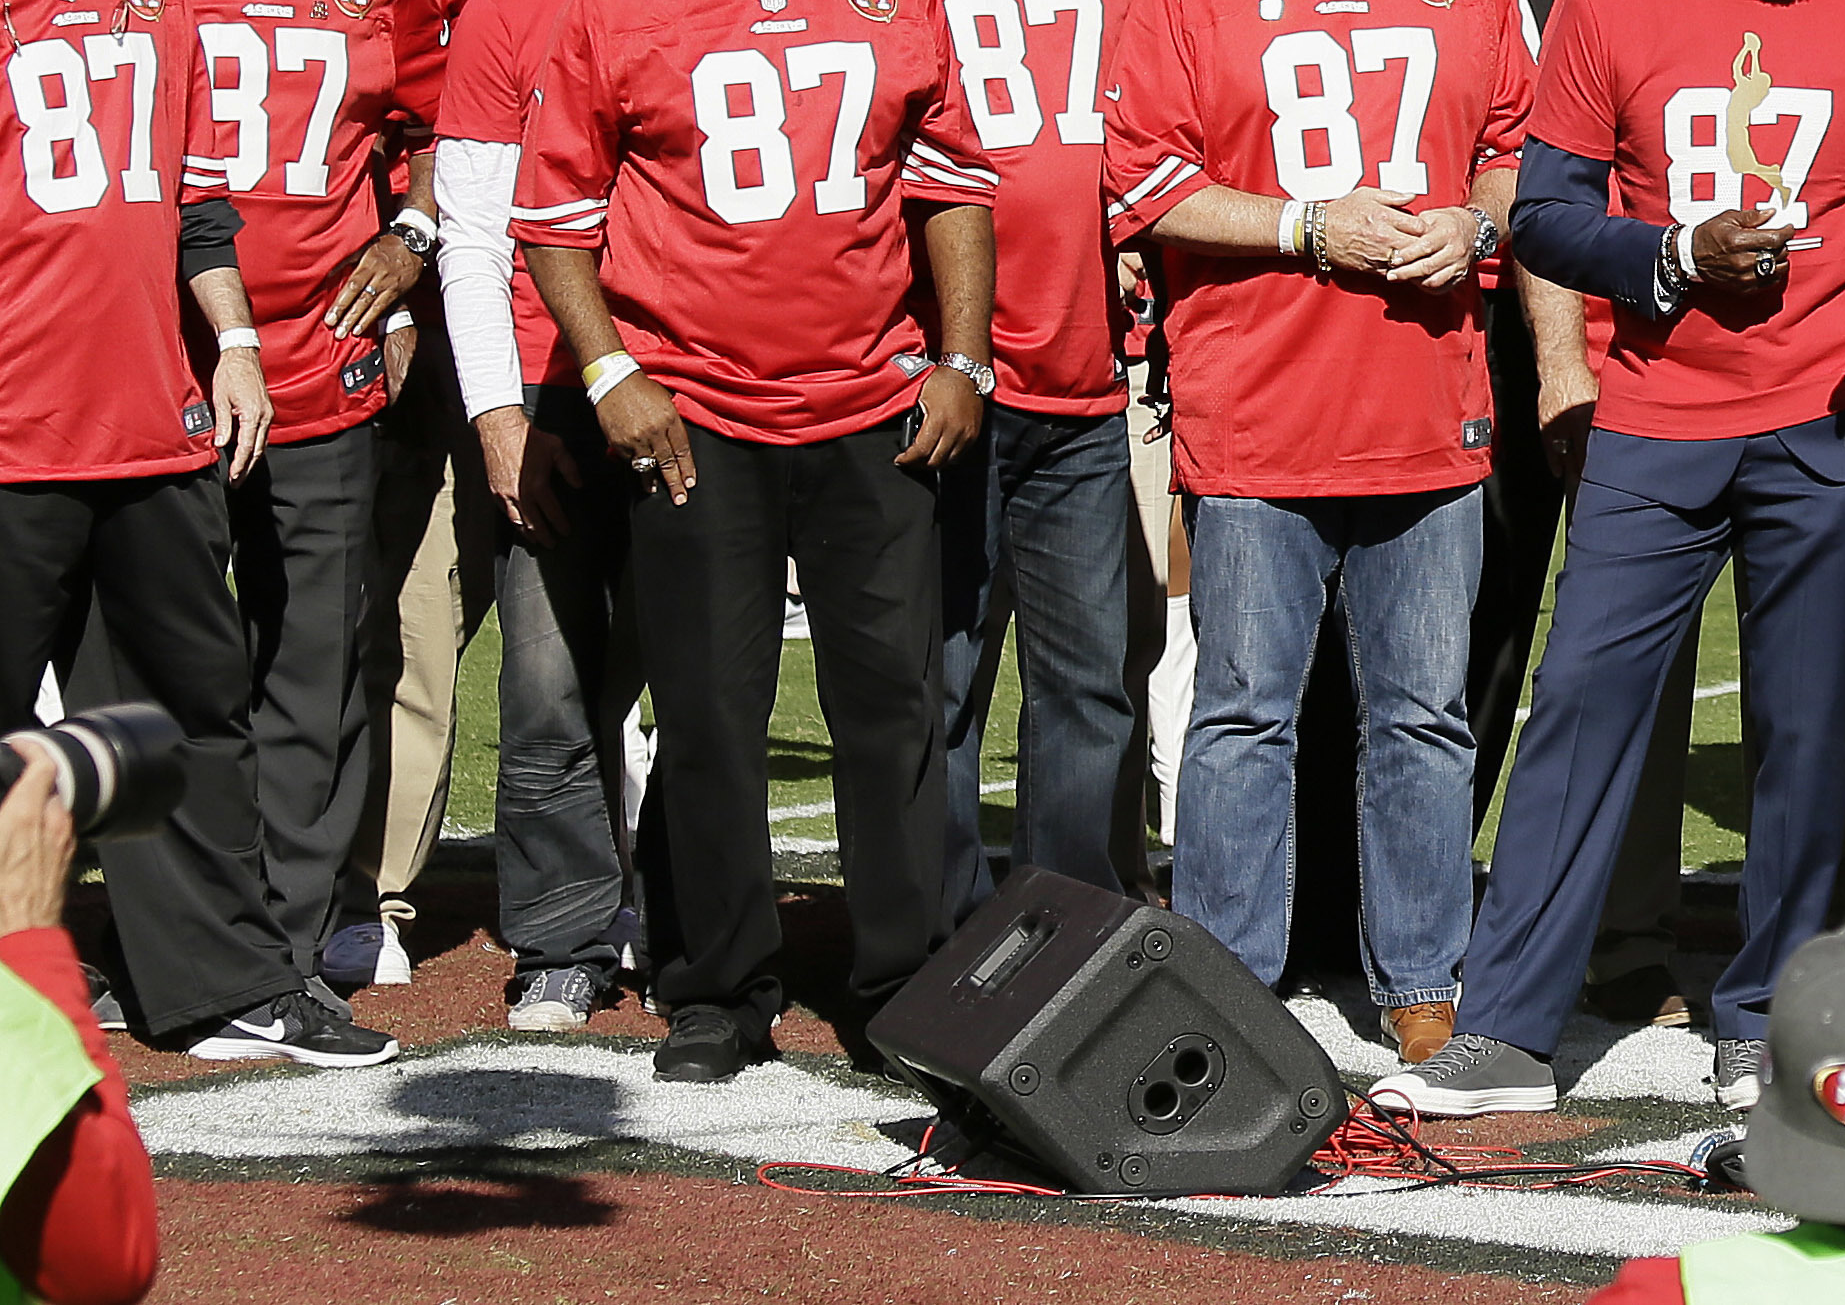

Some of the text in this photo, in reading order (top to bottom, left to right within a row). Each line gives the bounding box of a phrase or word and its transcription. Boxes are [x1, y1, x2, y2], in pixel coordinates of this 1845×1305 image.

[7, 37, 162, 214] 87
[692, 41, 876, 224] 87
[1261, 27, 1438, 202] 87
[1664, 86, 1834, 230] 87
